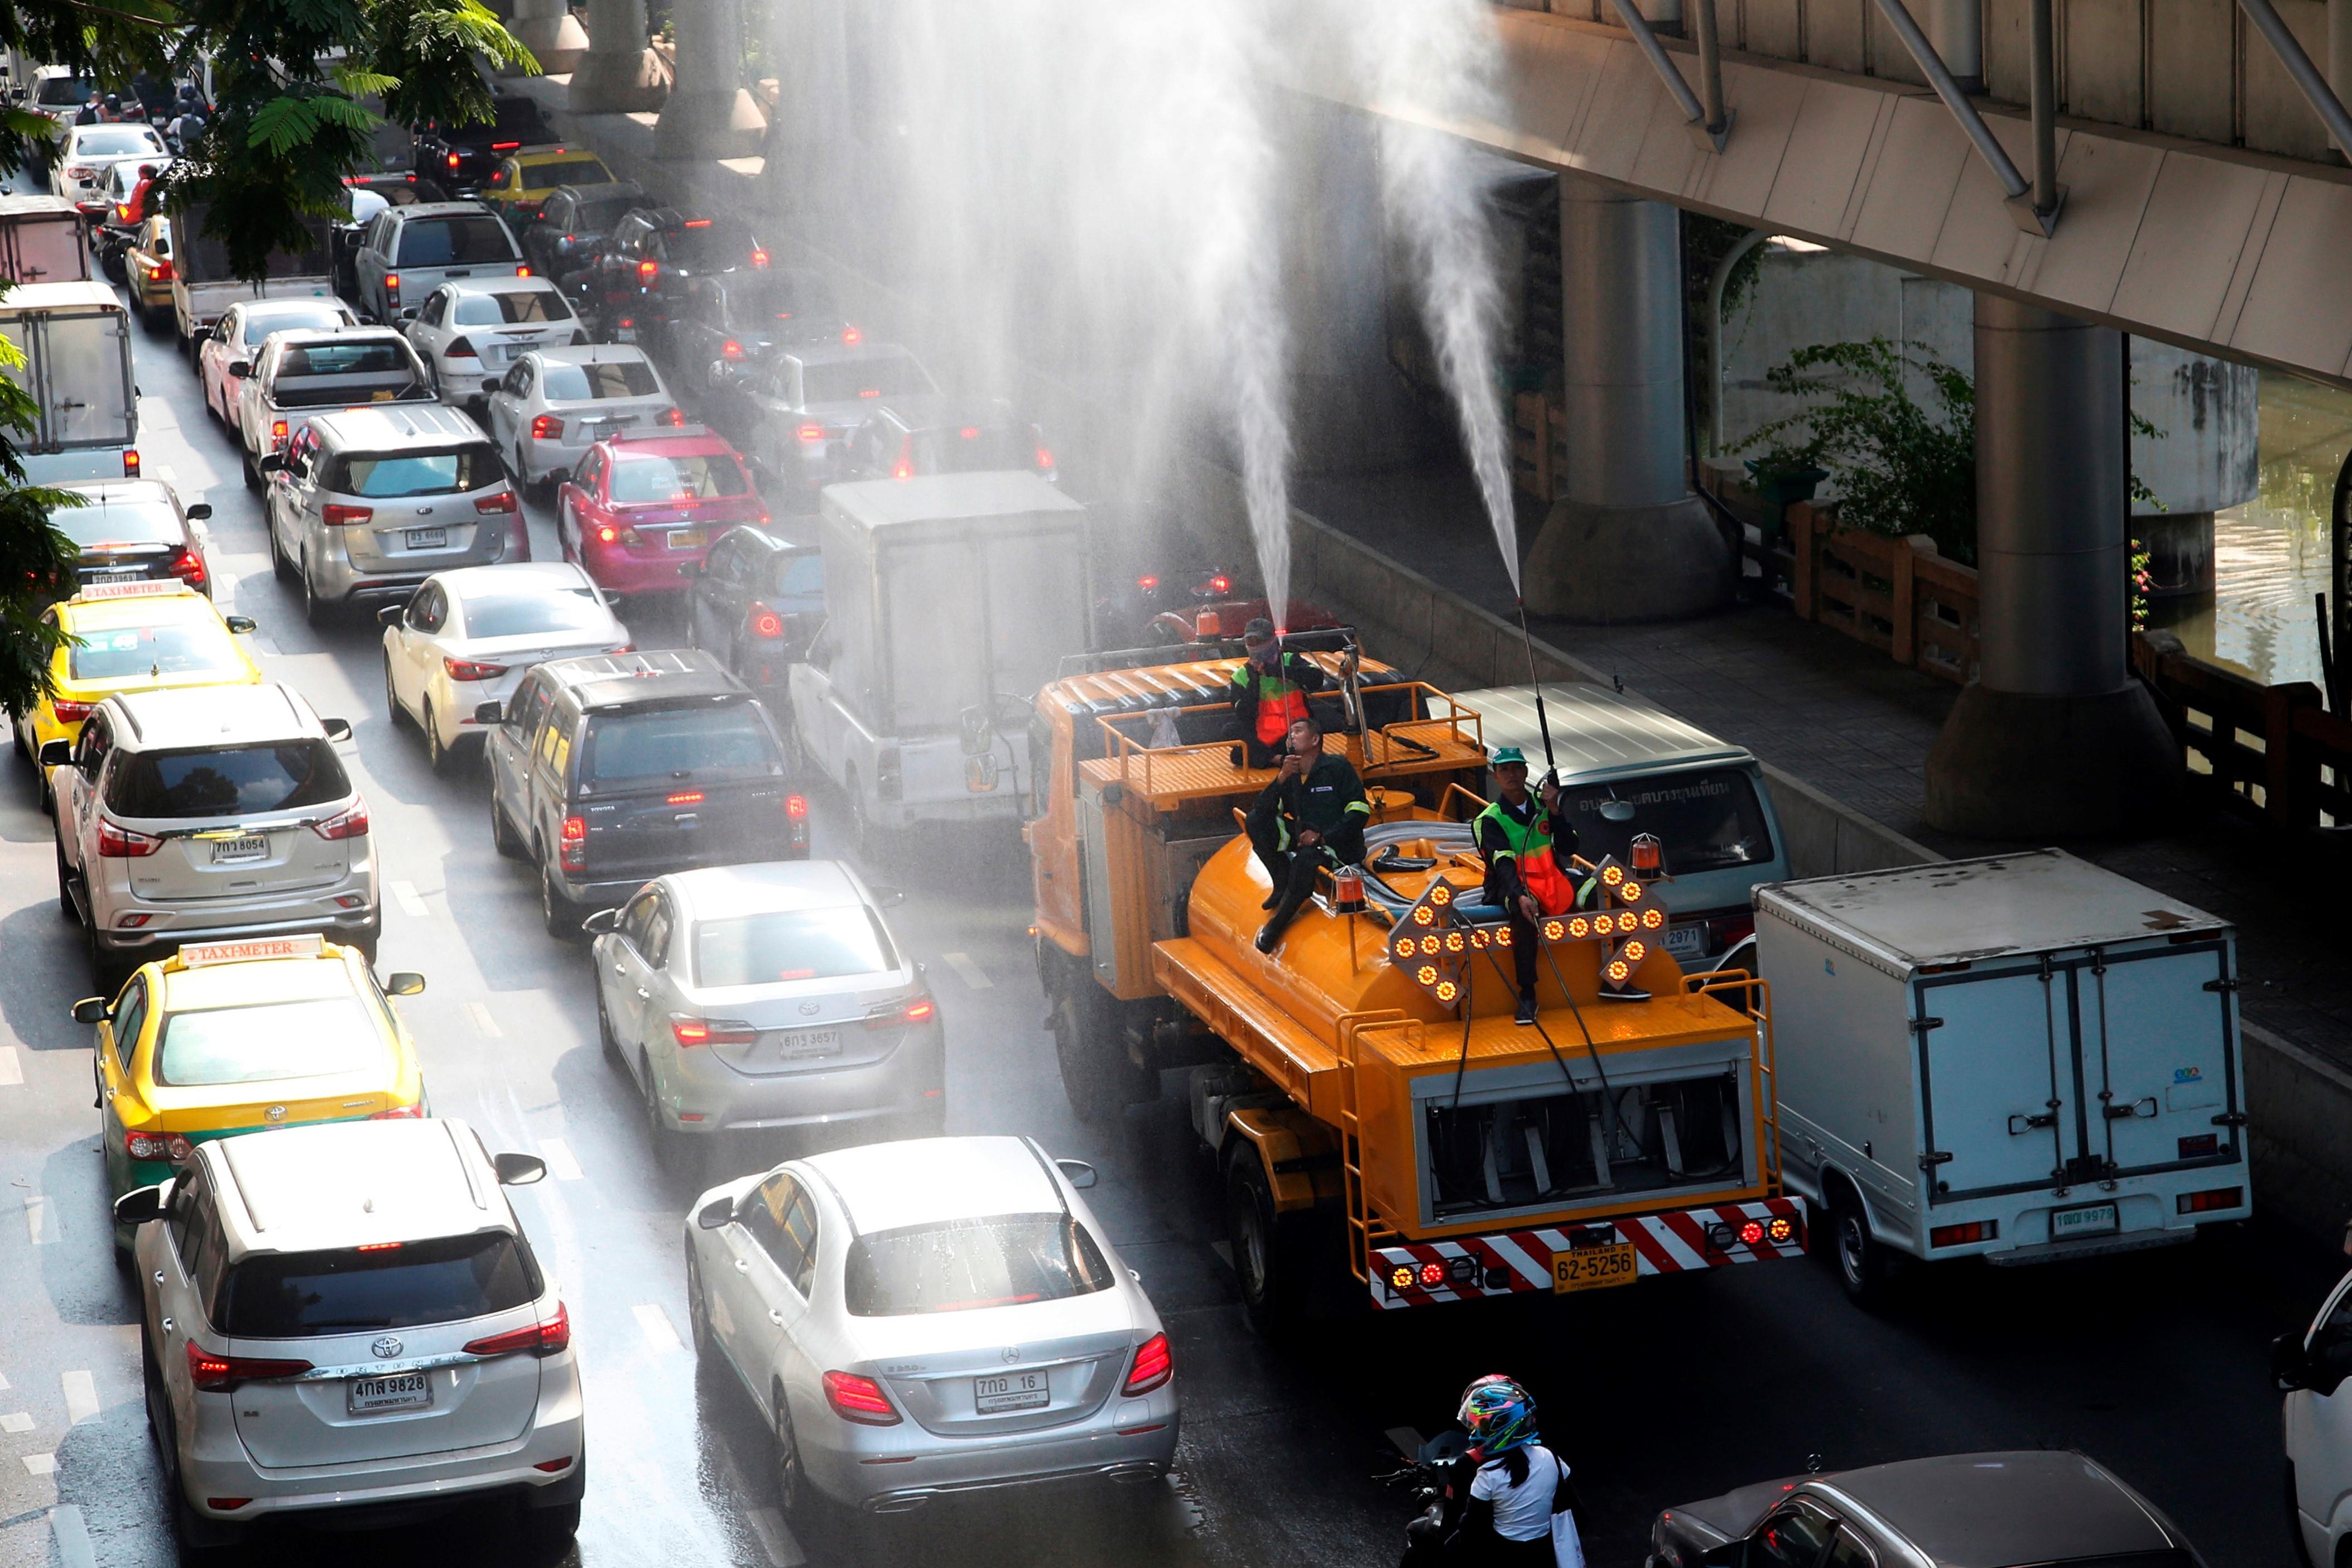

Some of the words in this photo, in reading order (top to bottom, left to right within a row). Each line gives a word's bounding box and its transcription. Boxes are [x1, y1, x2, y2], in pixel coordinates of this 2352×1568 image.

[93, 584, 162, 597] TAXI-METER
[216, 841, 237, 852] 7กว
[239, 839, 264, 850] 8054
[1669, 930, 1697, 944] 2971
[199, 941, 293, 960] TAXI-METER
[810, 1031, 836, 1043] 3657
[2084, 1208, 2114, 1222] 9979
[1571, 1247, 1617, 1258] THAILAND
[1557, 1253, 1631, 1281] 62-5256
[355, 1381, 385, 1397] 4กส
[389, 1377, 425, 1393] 9828
[979, 1378, 1008, 1394] 7กอ
[1020, 1375, 1036, 1389] 16
